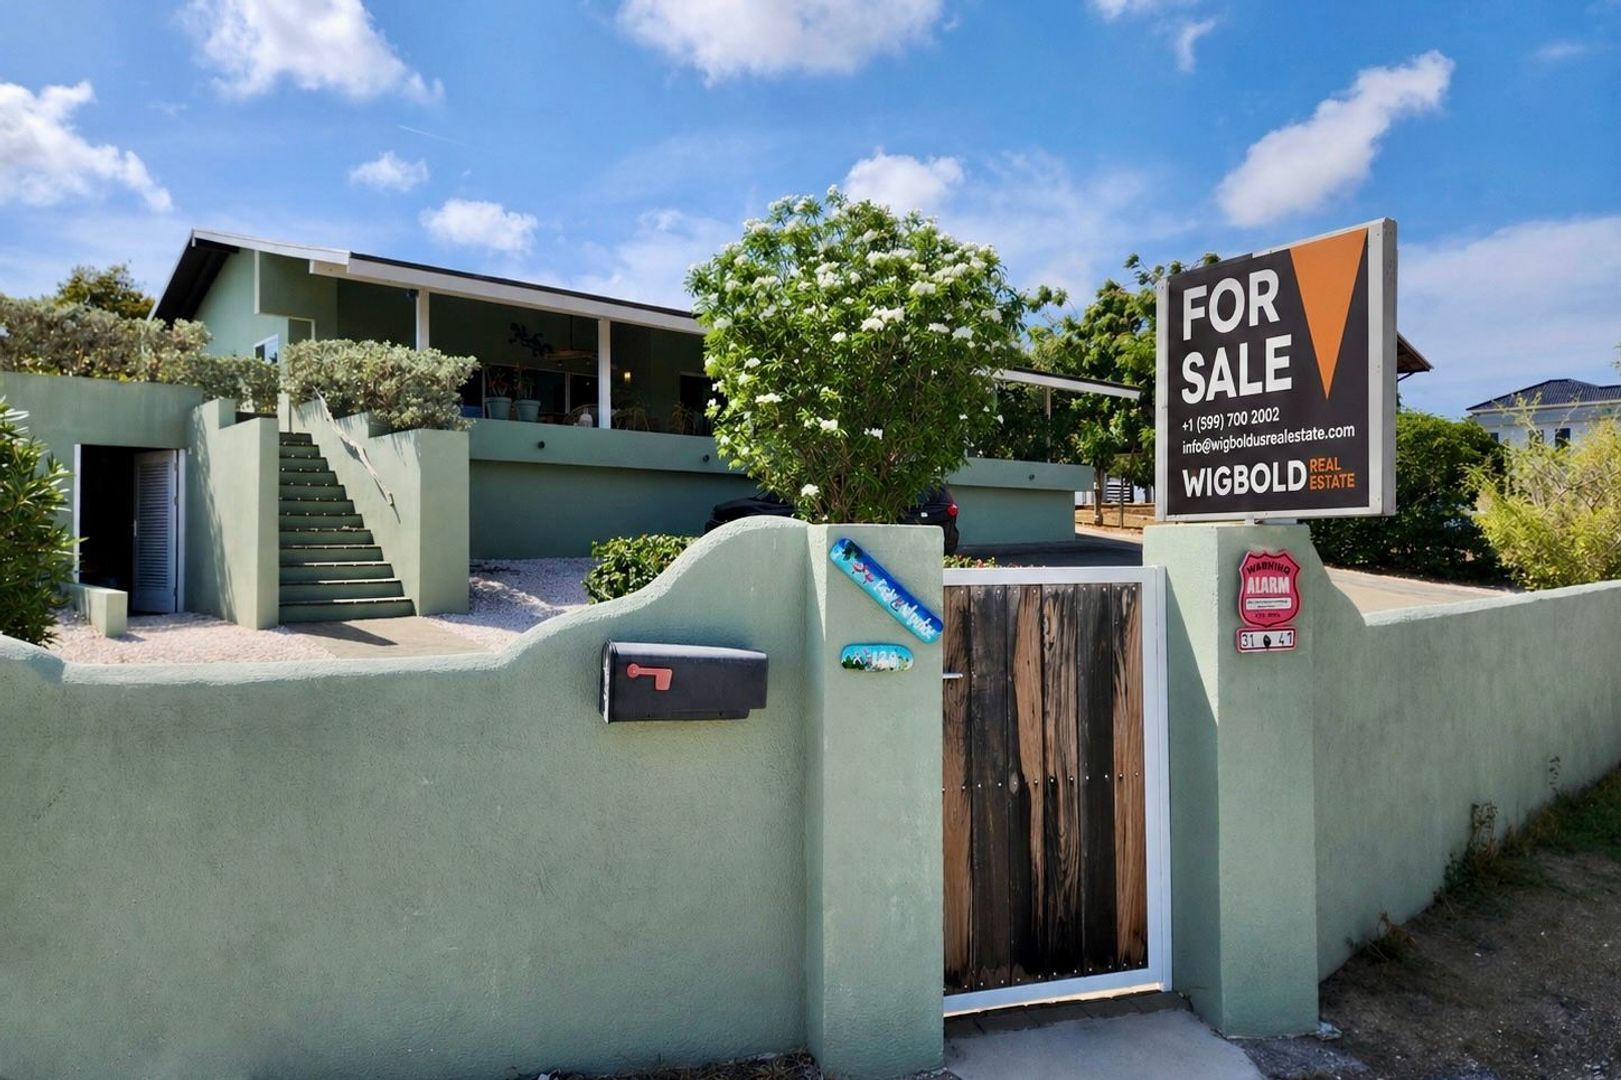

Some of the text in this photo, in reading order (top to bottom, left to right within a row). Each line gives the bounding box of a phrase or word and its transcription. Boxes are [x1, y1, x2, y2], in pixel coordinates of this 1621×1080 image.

[1183, 269, 1280, 341] FOR
[1181, 334, 1292, 404] SALE
[1182, 407, 1280, 433] +1 (599) 700 2002
[1182, 424, 1356, 454] info@wigboldusrealestate.com
[1182, 460, 1308, 498] WIGBOLD
[1309, 457, 1342, 473] REAL
[1309, 473, 1356, 490] ESTATE
[1247, 576, 1290, 594] ALARM
